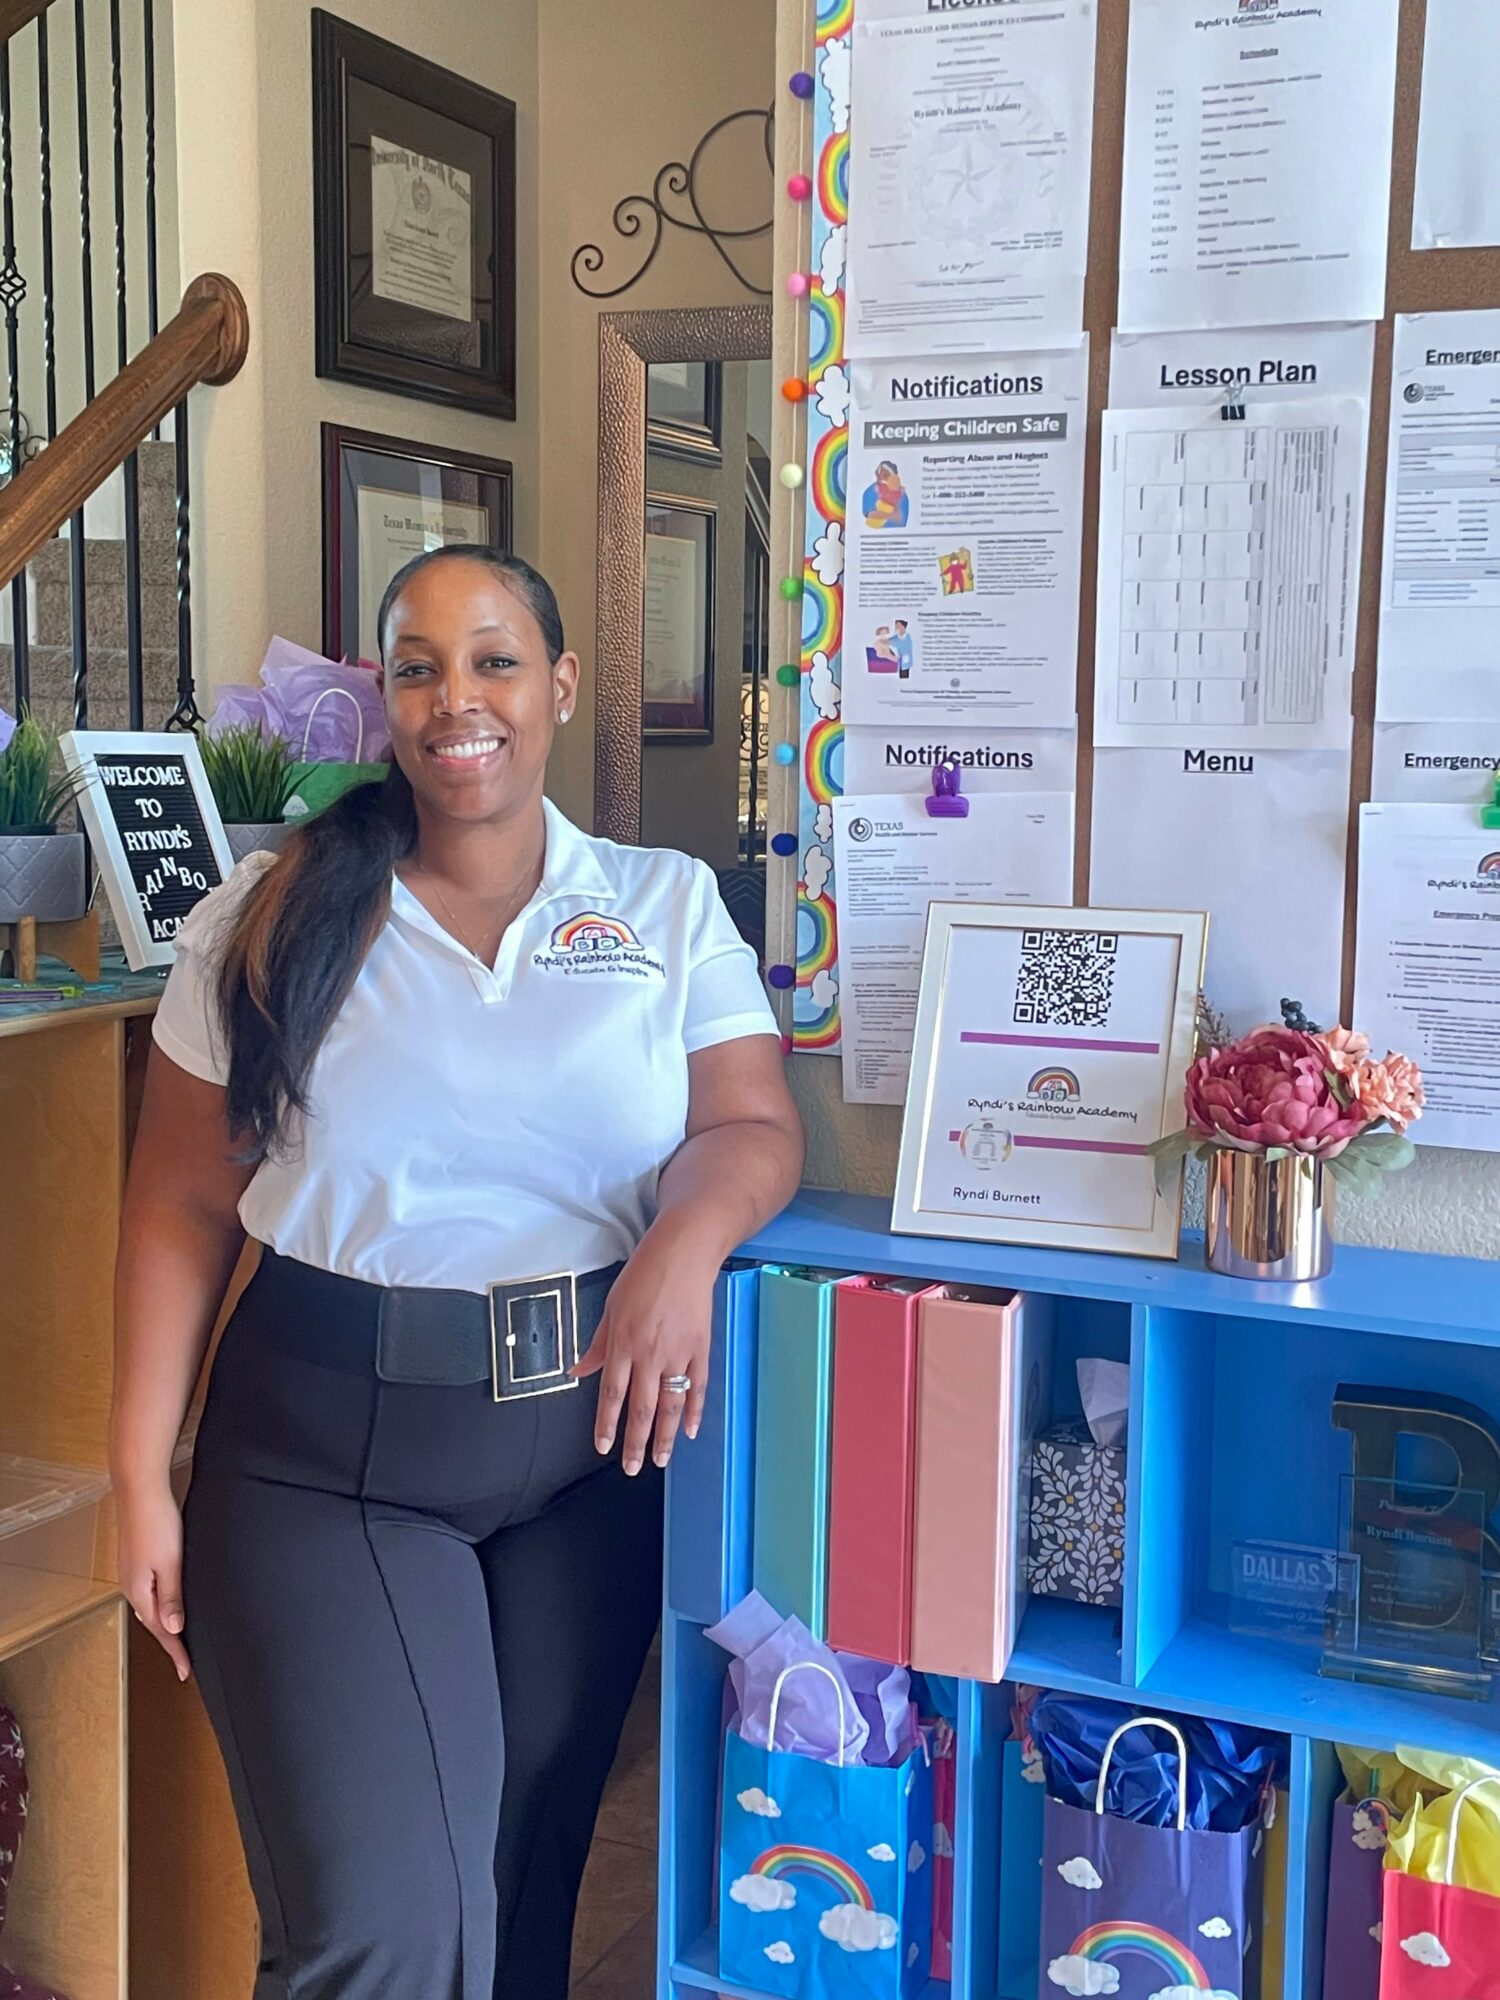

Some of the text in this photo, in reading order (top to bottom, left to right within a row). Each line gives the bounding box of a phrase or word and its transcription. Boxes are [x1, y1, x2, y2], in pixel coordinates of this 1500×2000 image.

[1276, 8, 1322, 18] Academy
[1160, 360, 1317, 386] Lesson Plan
[891, 373, 1043, 399] Notifications
[871, 417, 1060, 442] Keeping Children Safe
[922, 452, 1048, 464] Reporting Abuse and Neglect
[886, 744, 1033, 768] Notifications
[1183, 750, 1254, 771] Menu
[1404, 752, 1500, 771] Emergency
[99, 766, 185, 787] WELCOME
[135, 798, 163, 818] TO
[874, 822, 904, 831] TEXAS
[124, 824, 192, 851] RYNDI'S
[1427, 879, 1467, 890] Ryndi's
[533, 951, 665, 978] Ryndi's Rainbow Academy
[968, 1098, 1138, 1123] Ryndi's Rainbow Academy
[953, 1187, 1041, 1204] Ryndi Burnett
[1243, 1553, 1320, 1587] DALLAS
